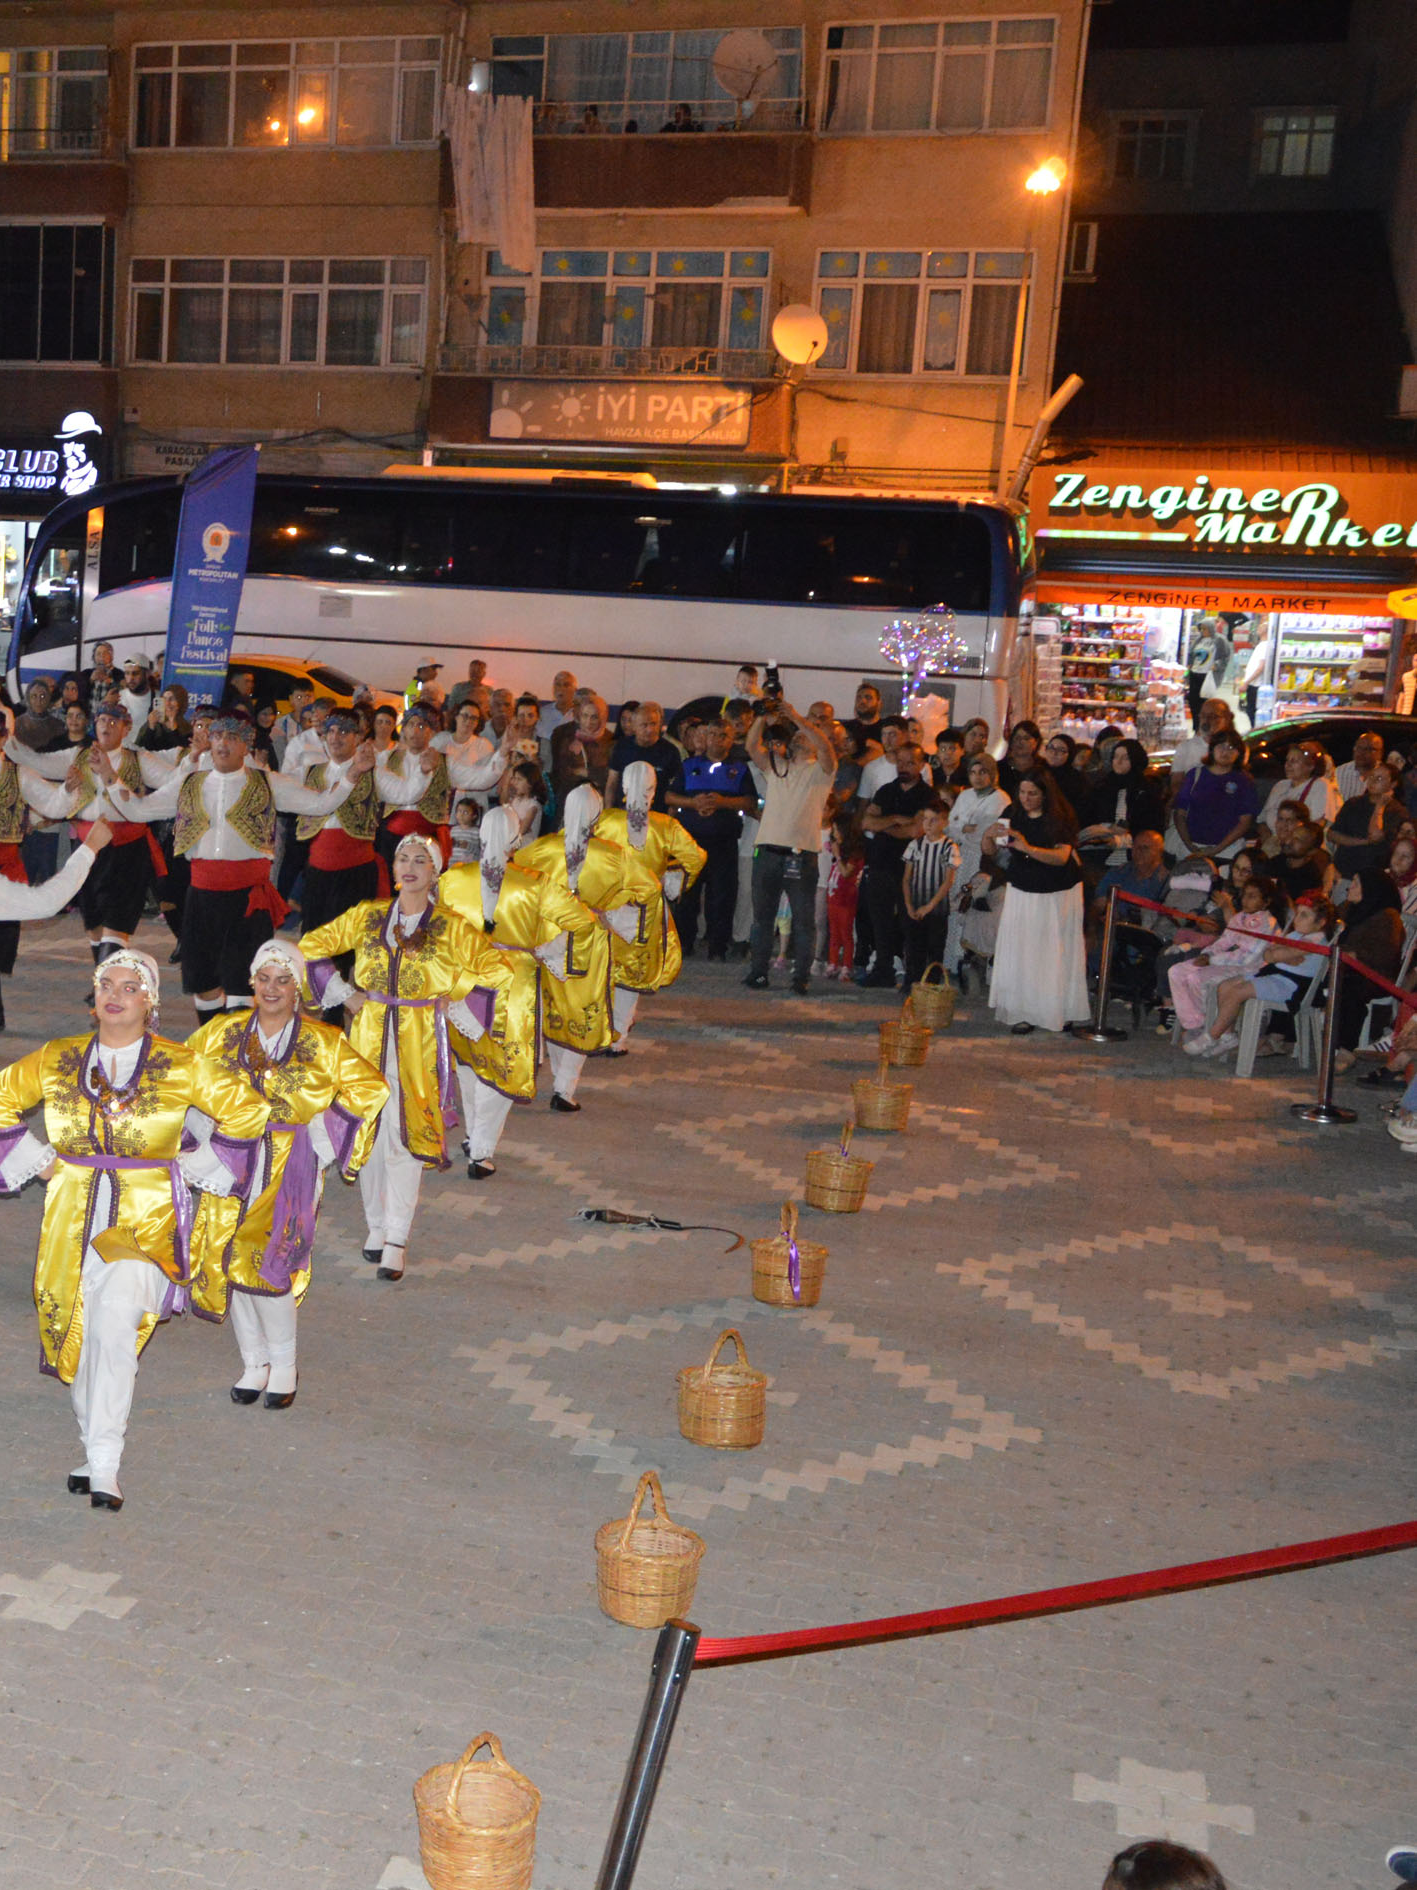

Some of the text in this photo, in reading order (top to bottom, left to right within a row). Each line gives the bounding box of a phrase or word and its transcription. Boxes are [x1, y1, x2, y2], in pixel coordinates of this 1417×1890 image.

[596, 385, 745, 425] İYİ PARTİ
[605, 426, 642, 439] HAVZA
[643, 426, 670, 440] İLÇE
[13, 475, 57, 490] SHOP
[1232, 596, 1332, 611] MARKET
[193, 618, 219, 634] Folk
[186, 631, 224, 647] Dance
[180, 645, 228, 662] Festival
